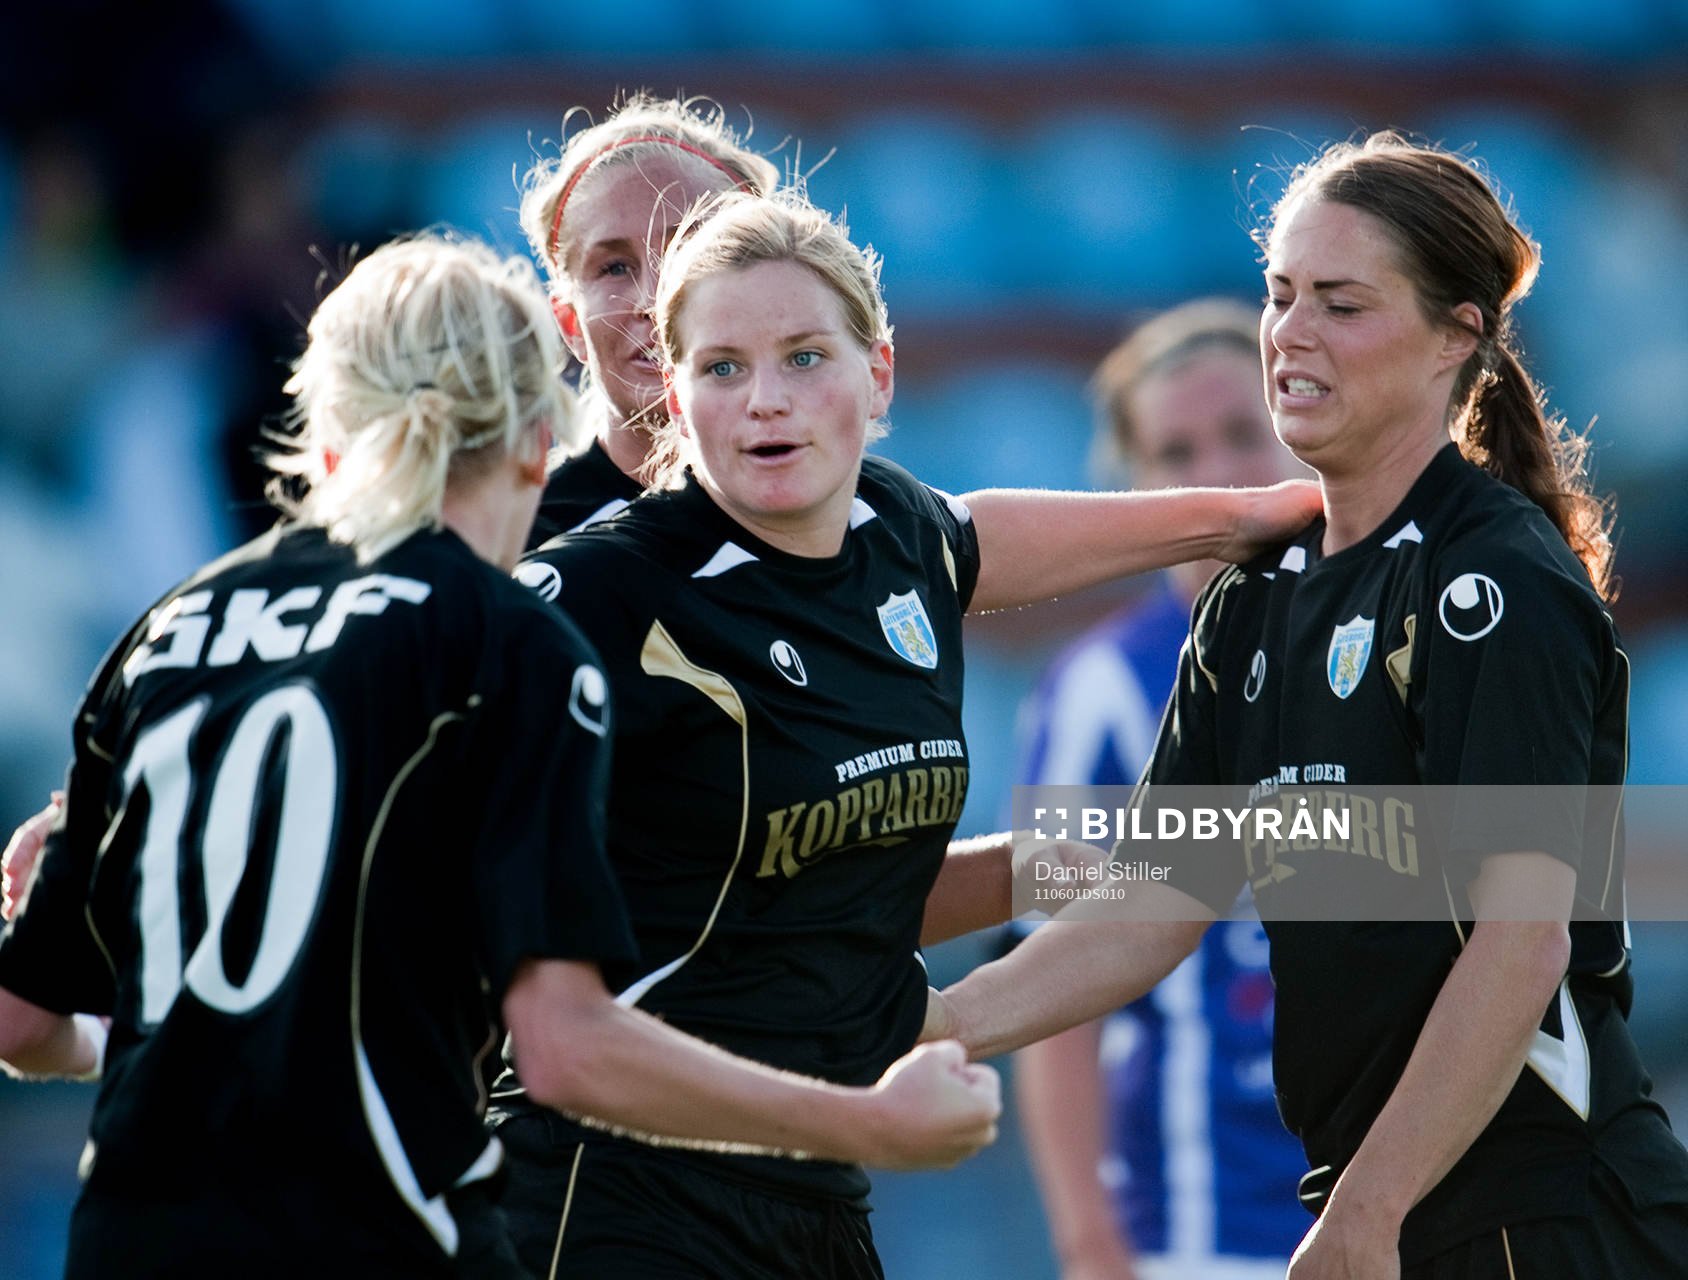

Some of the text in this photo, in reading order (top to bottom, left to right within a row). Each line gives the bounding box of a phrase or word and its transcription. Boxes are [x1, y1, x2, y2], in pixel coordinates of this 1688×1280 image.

[123, 573, 432, 688] SKF
[834, 739, 964, 784] PREMIUM CIDER
[1303, 763, 1346, 783] CIDER
[122, 684, 338, 1024] 10
